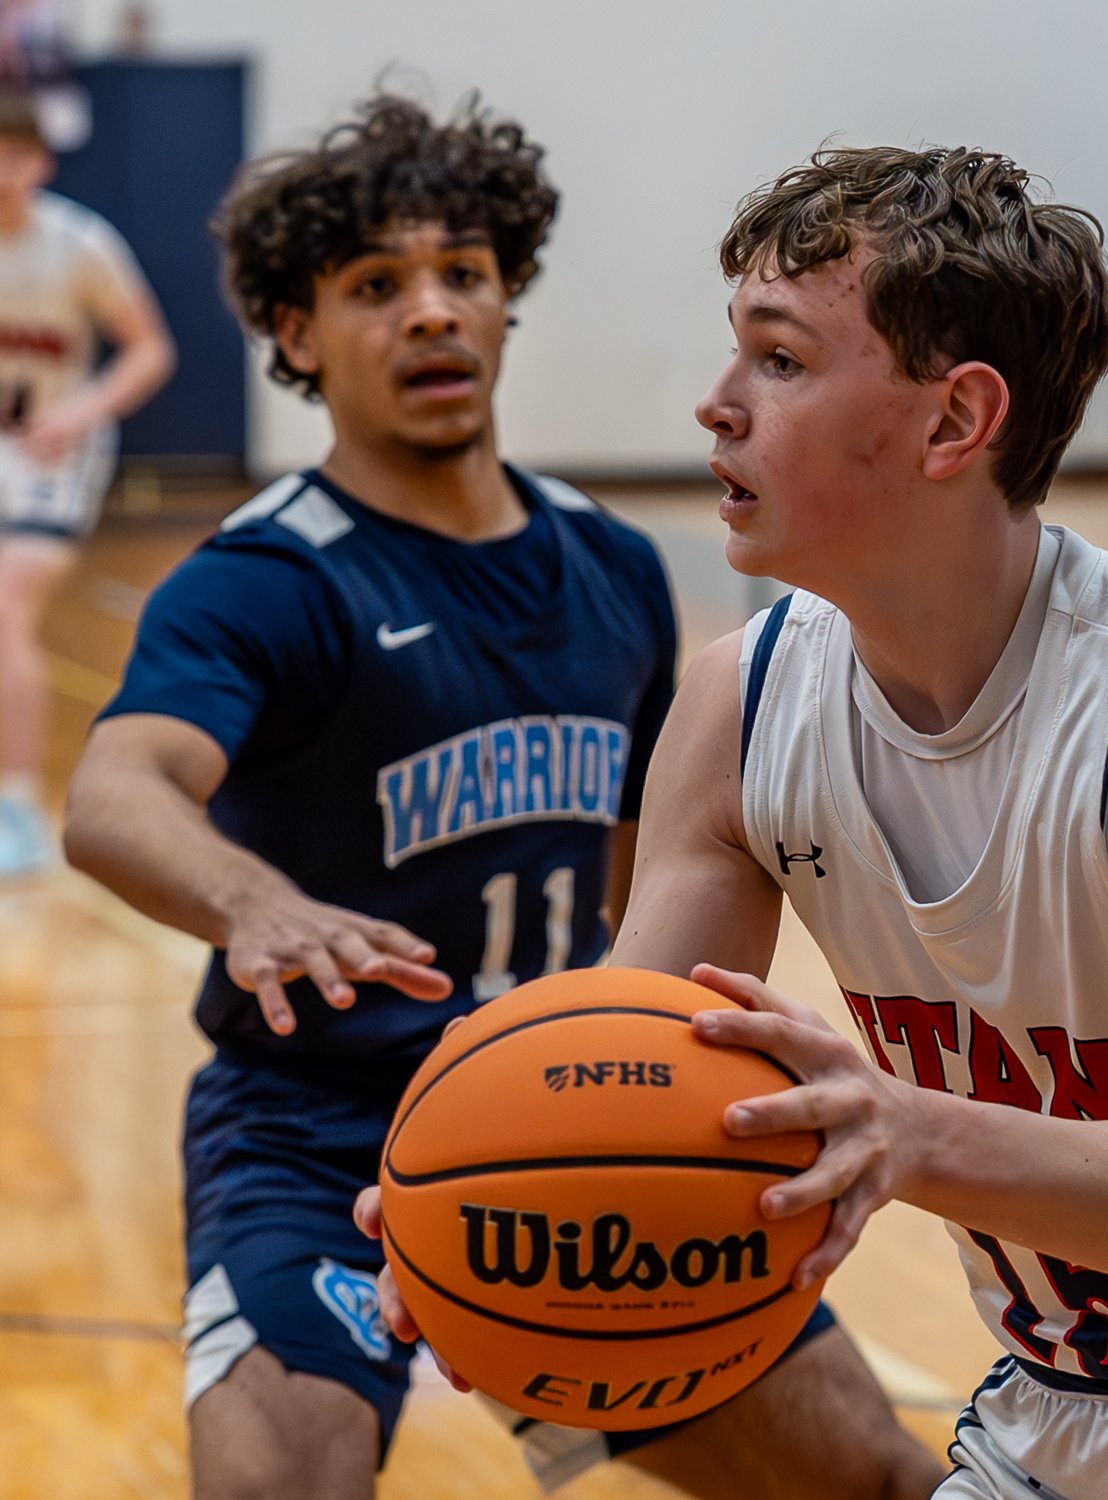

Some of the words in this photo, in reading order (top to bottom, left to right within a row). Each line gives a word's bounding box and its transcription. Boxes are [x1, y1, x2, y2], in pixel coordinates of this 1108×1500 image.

[472, 867, 575, 1001] 11
[572, 1060, 673, 1089] NFHS
[459, 1202, 770, 1293] Wilson
[522, 1368, 706, 1411] EVO
[709, 1337, 764, 1376] NXT
